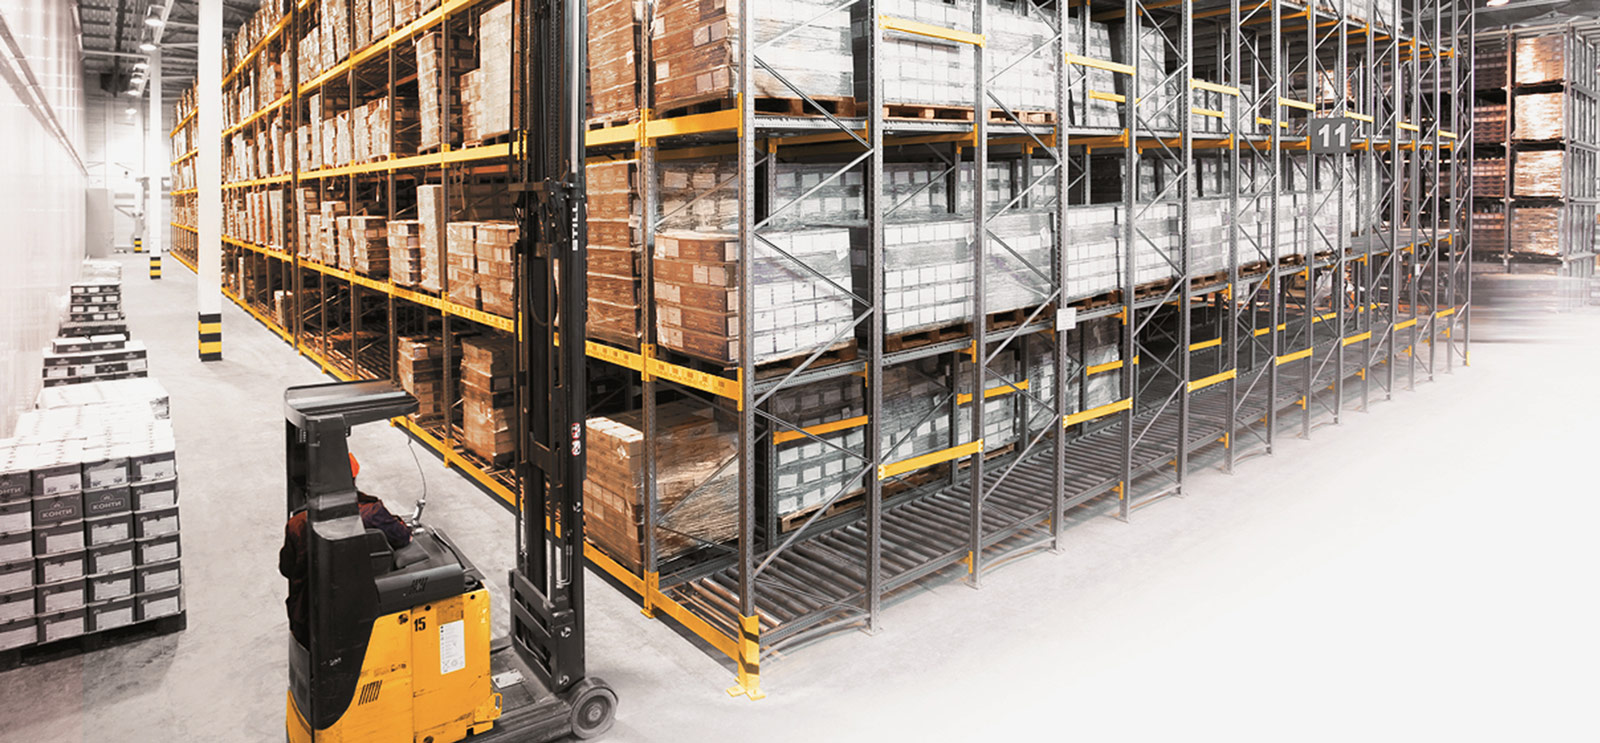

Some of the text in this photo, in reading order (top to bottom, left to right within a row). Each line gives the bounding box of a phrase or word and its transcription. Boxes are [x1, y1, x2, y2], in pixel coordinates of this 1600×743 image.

[1318, 123, 1346, 147] 11
[0, 487, 21, 495] ОНТИ
[92, 501, 122, 510] КОНТИ
[42, 509, 73, 518] КОНТИ
[414, 616, 426, 632] 15
